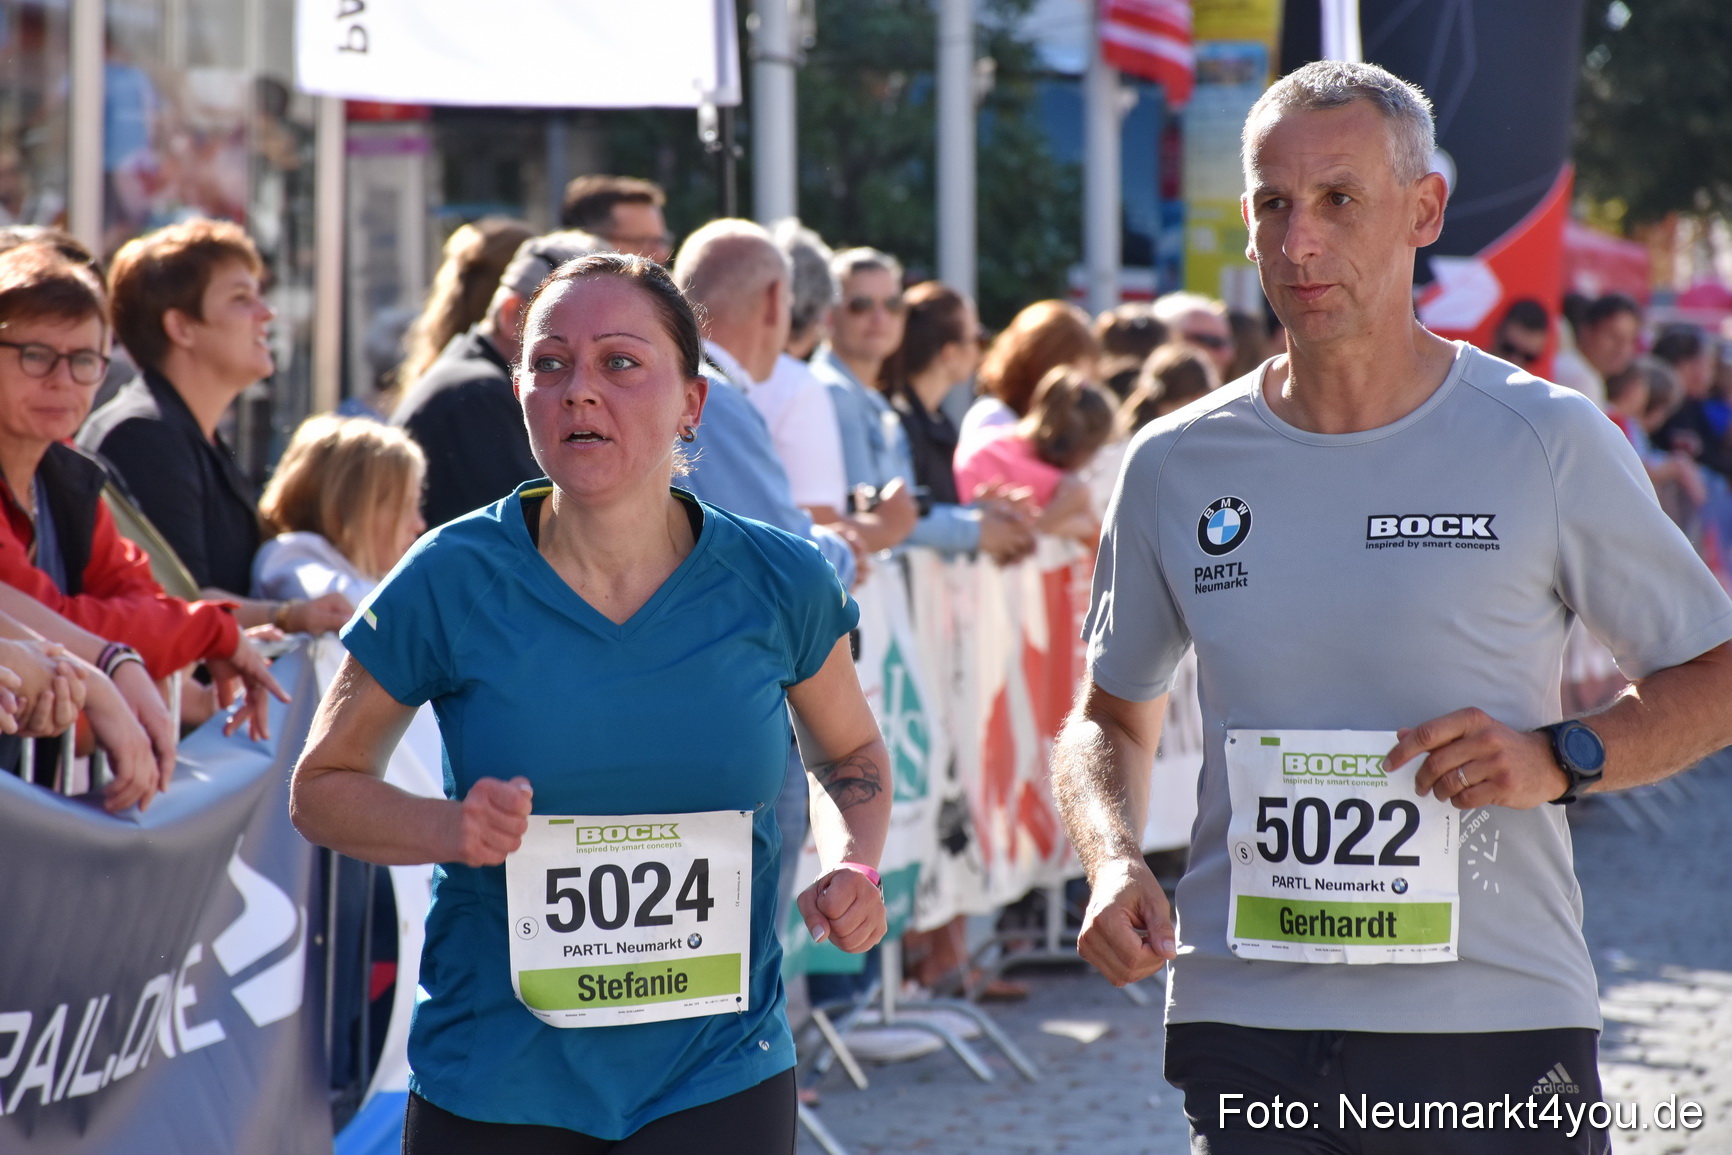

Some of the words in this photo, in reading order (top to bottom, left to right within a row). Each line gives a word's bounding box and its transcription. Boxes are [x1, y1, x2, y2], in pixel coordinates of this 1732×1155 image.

[1204, 498, 1248, 520] BMW
[1367, 514, 1498, 540] BOCK
[1365, 540, 1405, 550] inspired
[1407, 540, 1419, 549] by
[1455, 541, 1500, 551] concepts
[1195, 562, 1248, 582] PARTL
[1195, 577, 1248, 594] Neumarkt
[1283, 753, 1387, 778] BOCK
[1283, 777, 1312, 786] inspired
[1314, 778, 1325, 786] by
[1327, 778, 1350, 786] smart
[1351, 779, 1389, 787] concepts
[1256, 797, 1421, 867] 5022
[1467, 810, 1490, 834] 2018
[576, 823, 680, 845] BOCK
[576, 845, 608, 854] inspired
[610, 844, 620, 852] by
[622, 842, 645, 850] smart
[647, 841, 682, 850] concepts
[1272, 875, 1311, 890] PARTL
[1315, 878, 1385, 892] Neumarkt
[546, 858, 714, 933] 5024
[1280, 907, 1397, 938] Gerhardt
[563, 943, 613, 957] PARTL
[616, 938, 682, 954] Neumarkt
[578, 968, 688, 1002] Stefanie
[1532, 1082, 1579, 1094] adidas
